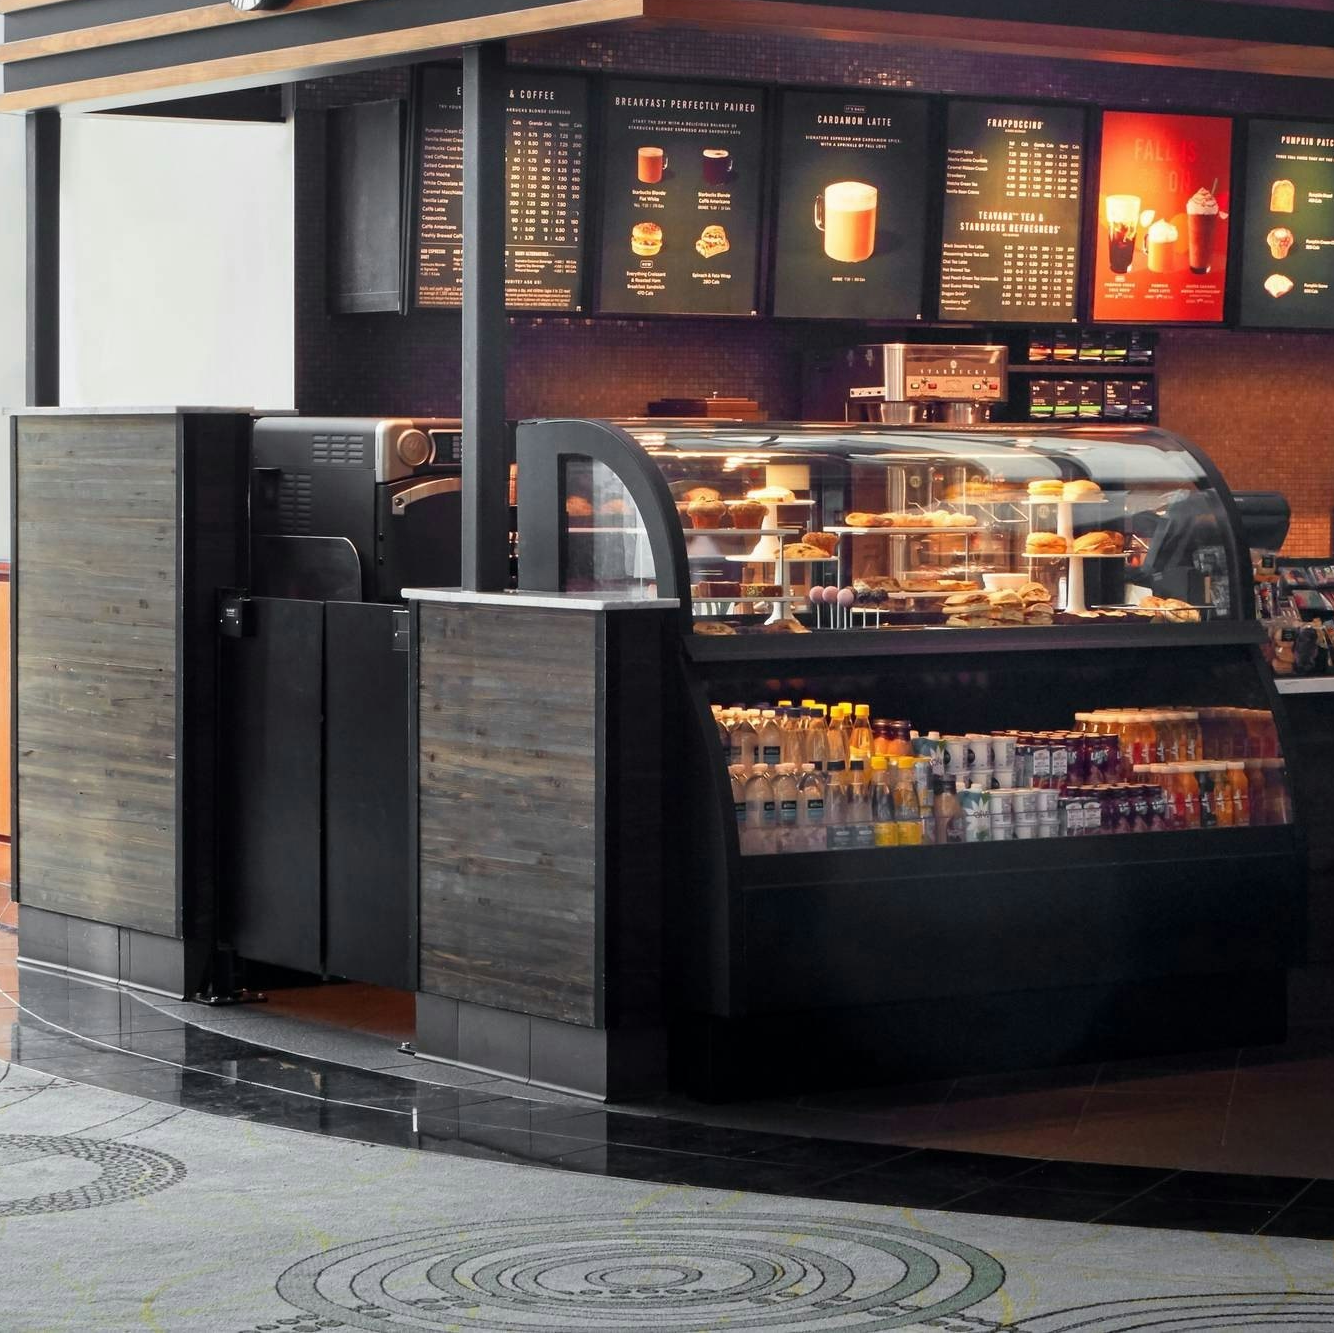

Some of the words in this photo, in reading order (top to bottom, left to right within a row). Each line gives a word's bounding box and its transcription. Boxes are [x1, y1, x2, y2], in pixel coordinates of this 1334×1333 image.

[520, 90, 554, 100] COFFEE
[615, 97, 666, 108] BREAKFAST
[670, 100, 720, 111] PERFECTLY
[724, 103, 755, 113] PAIRED
[817, 115, 863, 125] CARDAMOM
[867, 117, 892, 127] LATTE
[1281, 136, 1314, 146] PUMPKIN
[1134, 137, 1171, 162] FALL
[1020, 212, 1035, 222] TEA
[959, 222, 1006, 233] STARBUCKS
